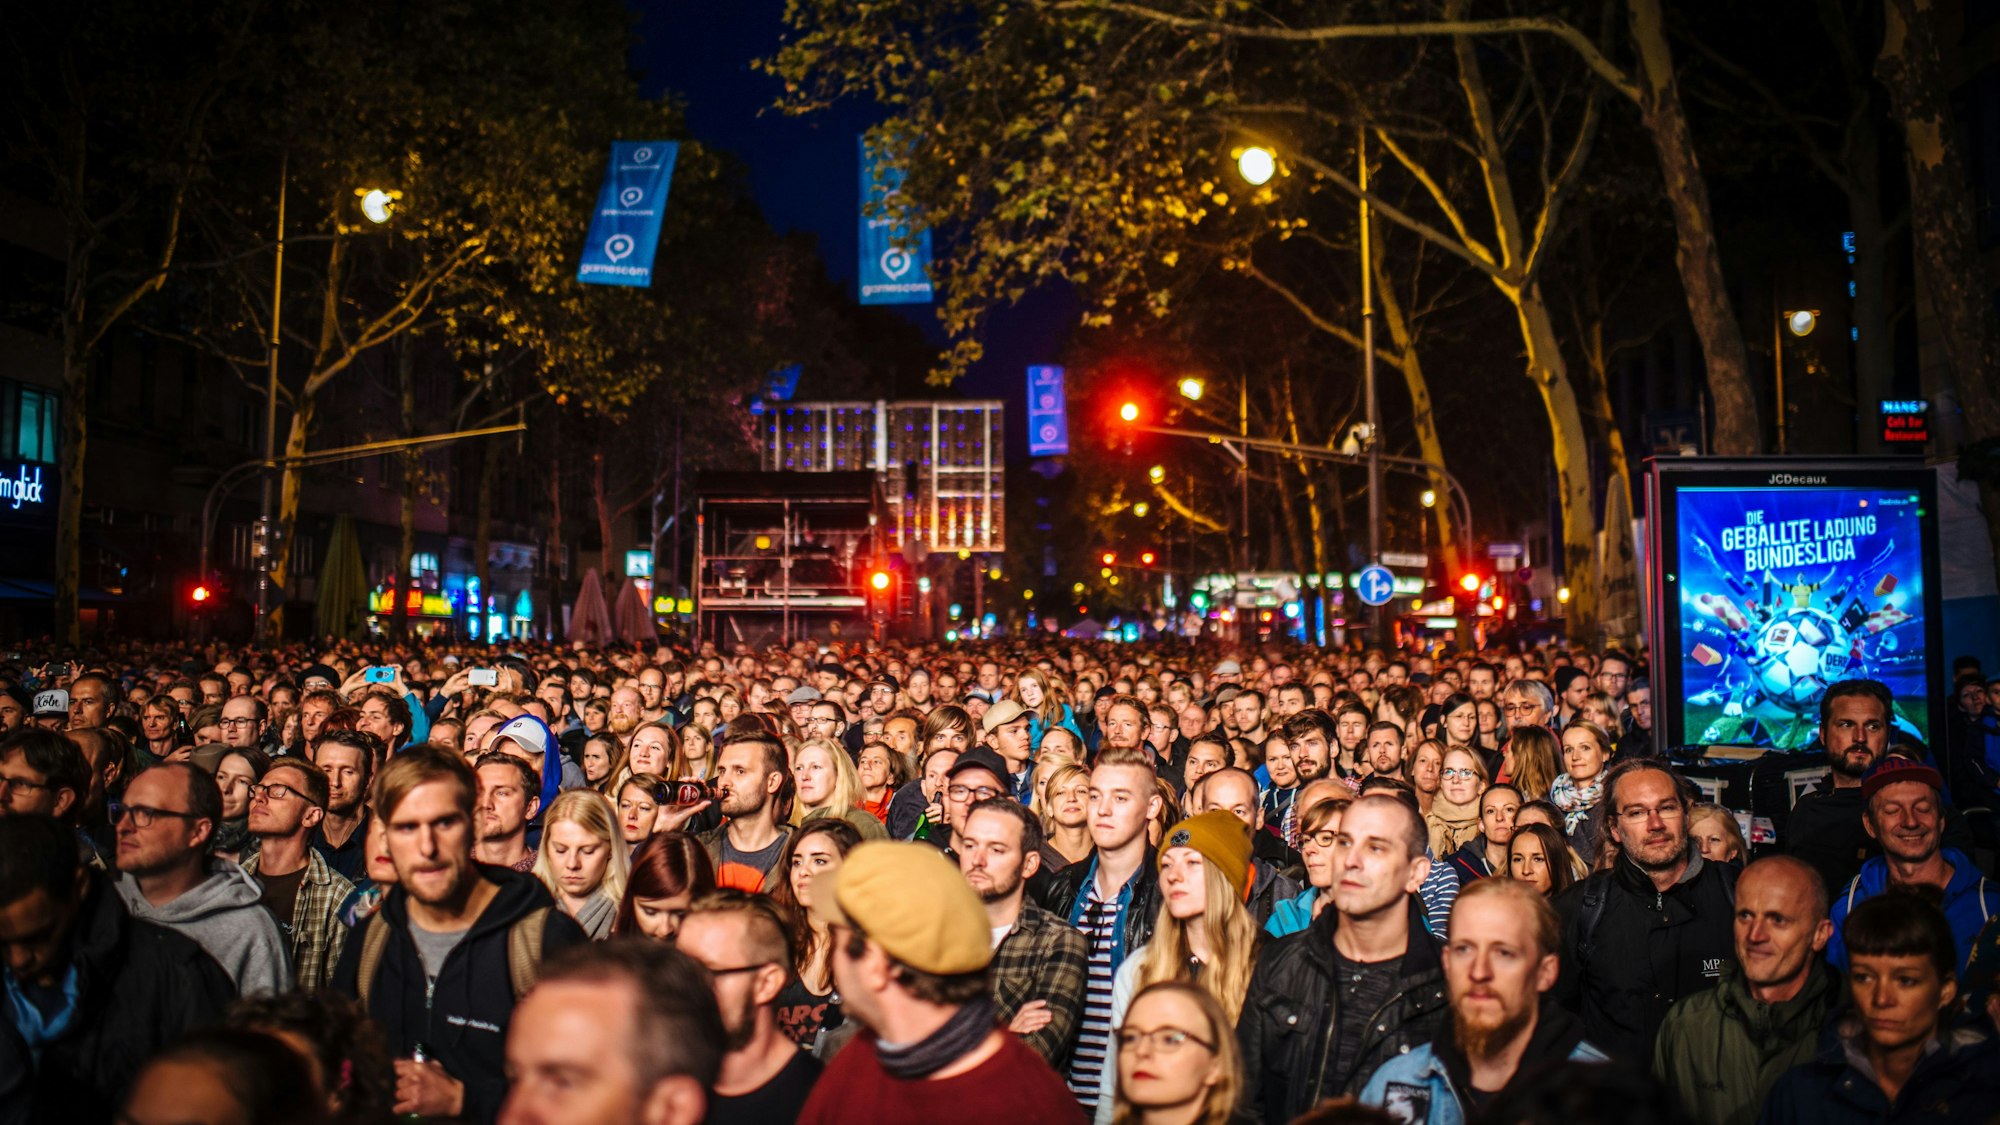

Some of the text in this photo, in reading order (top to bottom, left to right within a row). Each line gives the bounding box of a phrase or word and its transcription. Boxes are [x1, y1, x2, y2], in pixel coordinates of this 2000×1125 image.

[581, 263, 648, 276] gamescom
[862, 283, 931, 297] gamescom
[1768, 474, 1827, 484] JCDecaux
[12, 465, 42, 509] glück
[1746, 510, 1764, 525] DIE
[1722, 515, 1876, 551] GEBALLTE LADUNG
[1745, 539, 1856, 572] BUNDESLIGA
[36, 694, 60, 708] Köln
